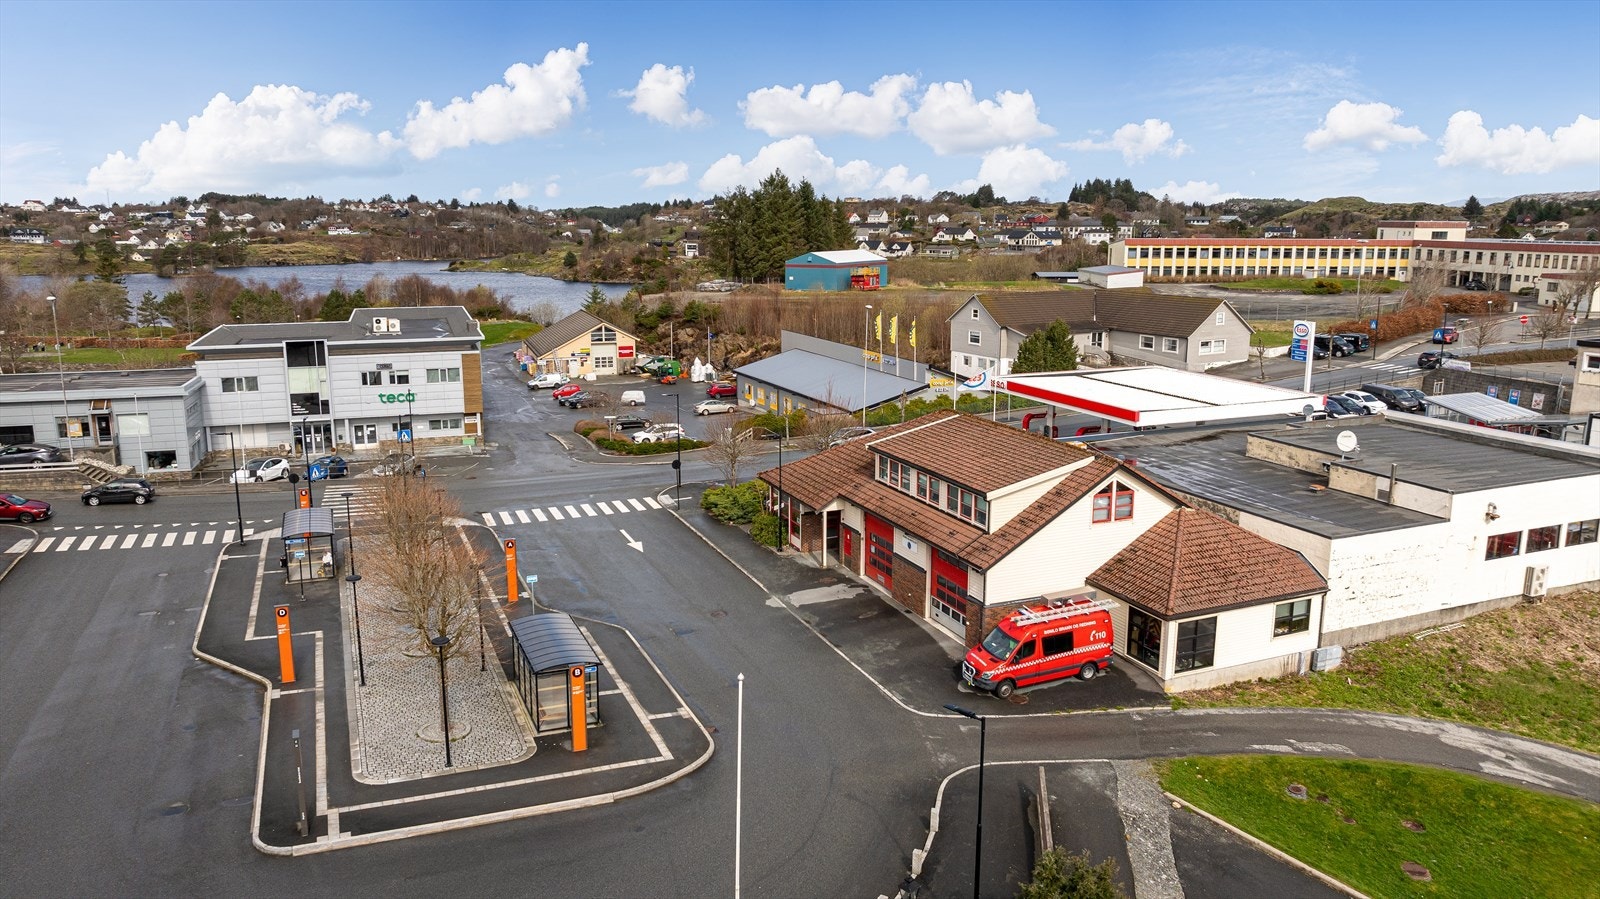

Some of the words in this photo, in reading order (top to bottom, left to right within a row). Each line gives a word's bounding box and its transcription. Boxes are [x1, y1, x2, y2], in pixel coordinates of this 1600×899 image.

[1296, 326, 1307, 334] Esso
[378, 392, 415, 404] teca
[1095, 631, 1106, 640] 110
